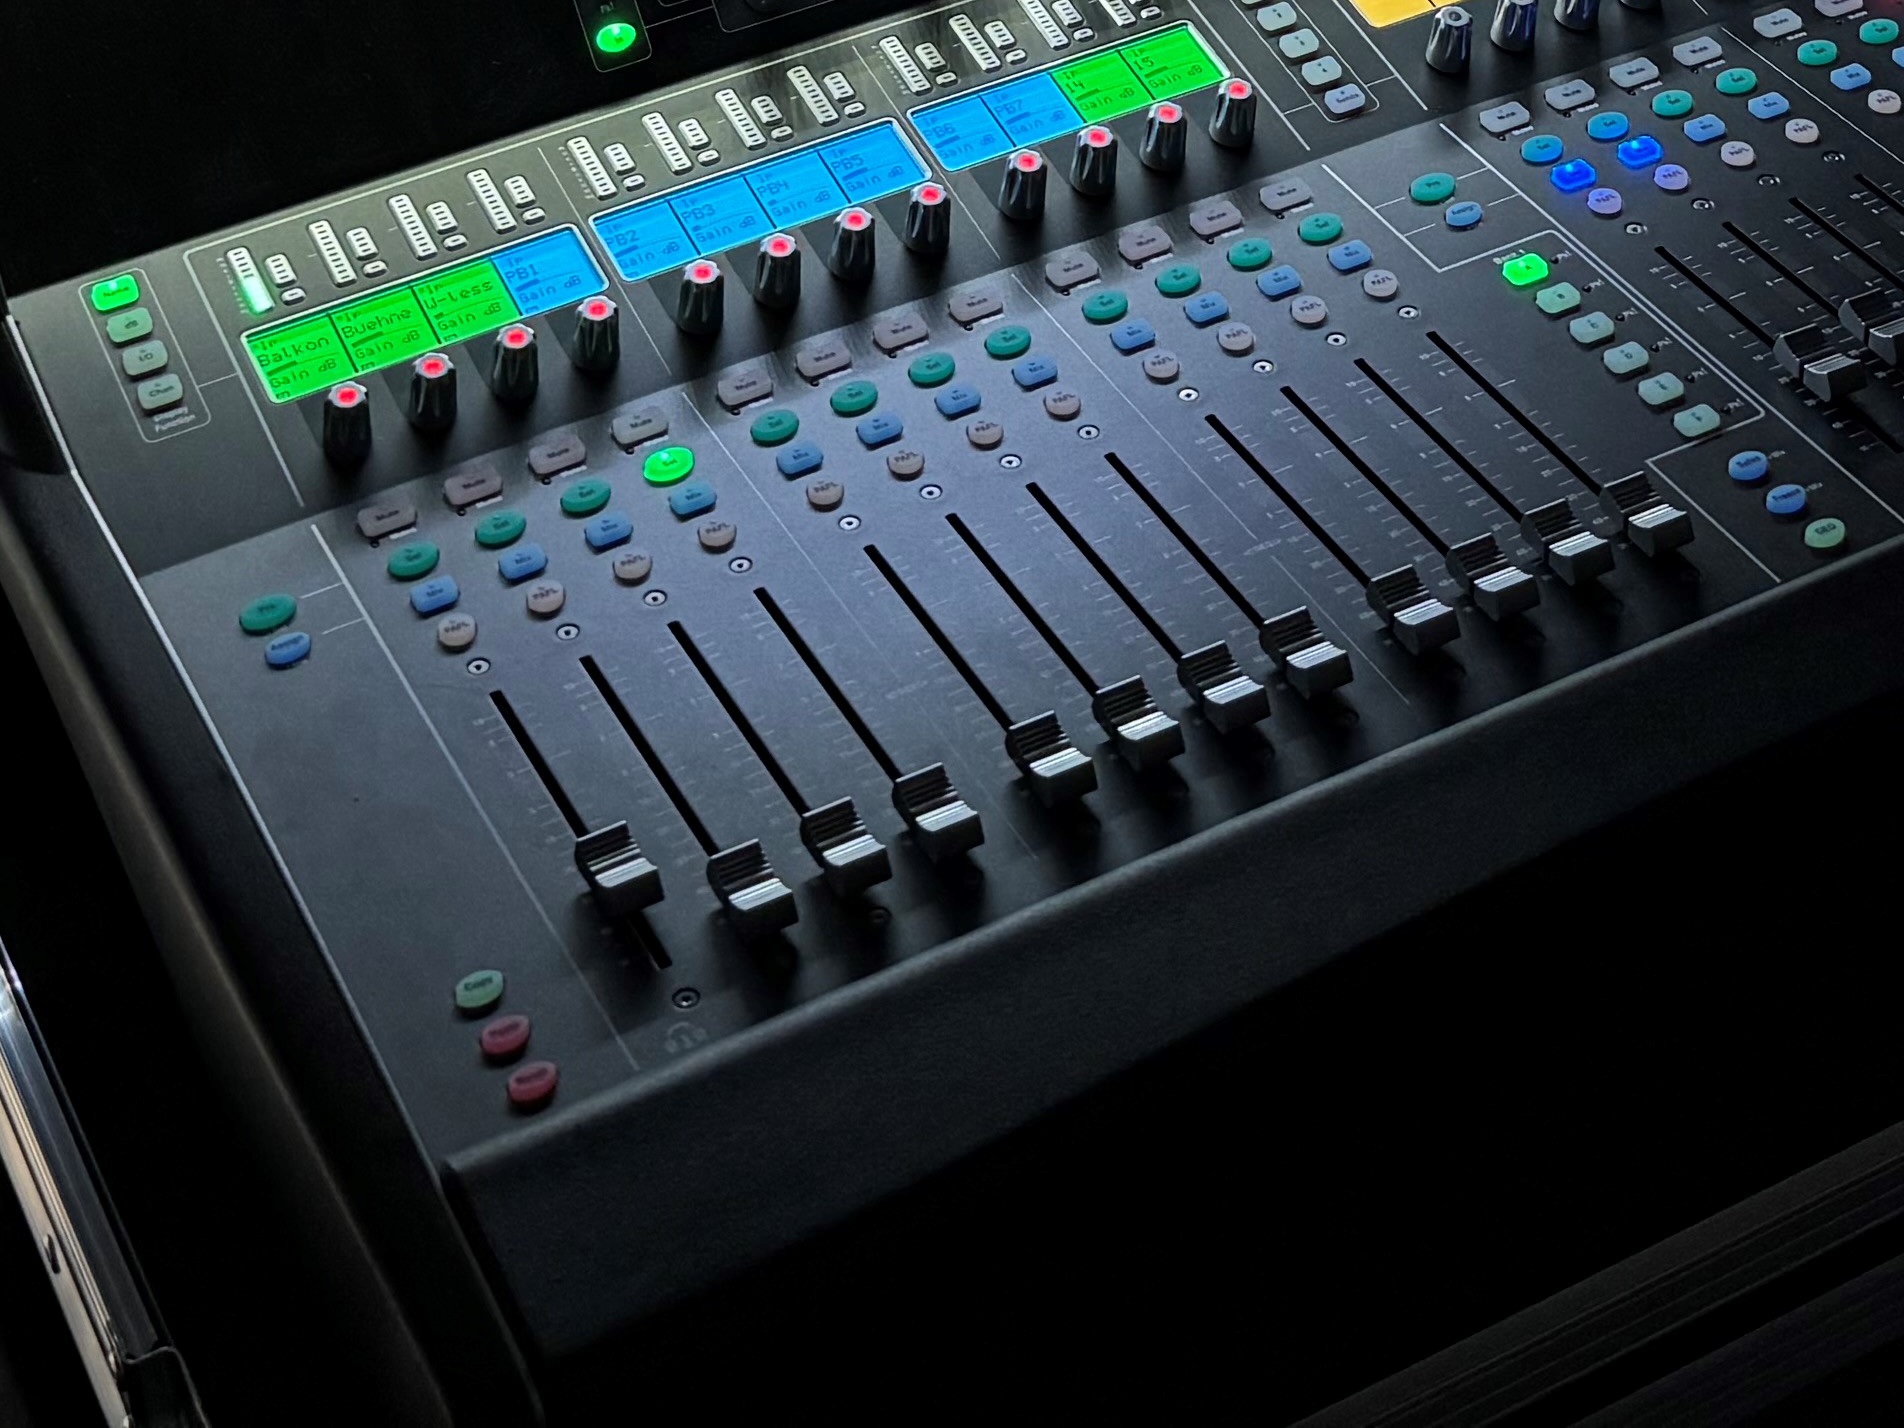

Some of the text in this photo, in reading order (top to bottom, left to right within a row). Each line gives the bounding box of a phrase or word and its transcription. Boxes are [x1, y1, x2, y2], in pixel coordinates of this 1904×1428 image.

[680, 203, 716, 223] PB3
[604, 228, 640, 247] PB2
[694, 223, 734, 244] Gain
[618, 250, 657, 270] Gain
[504, 263, 540, 285] PB1
[423, 280, 494, 312] W-less
[518, 283, 558, 305] Gain
[340, 307, 412, 340] Buehne
[437, 311, 477, 333] Gain
[256, 335, 331, 369] Balkon
[354, 340, 394, 361] Gain
[269, 369, 310, 389] Gain
